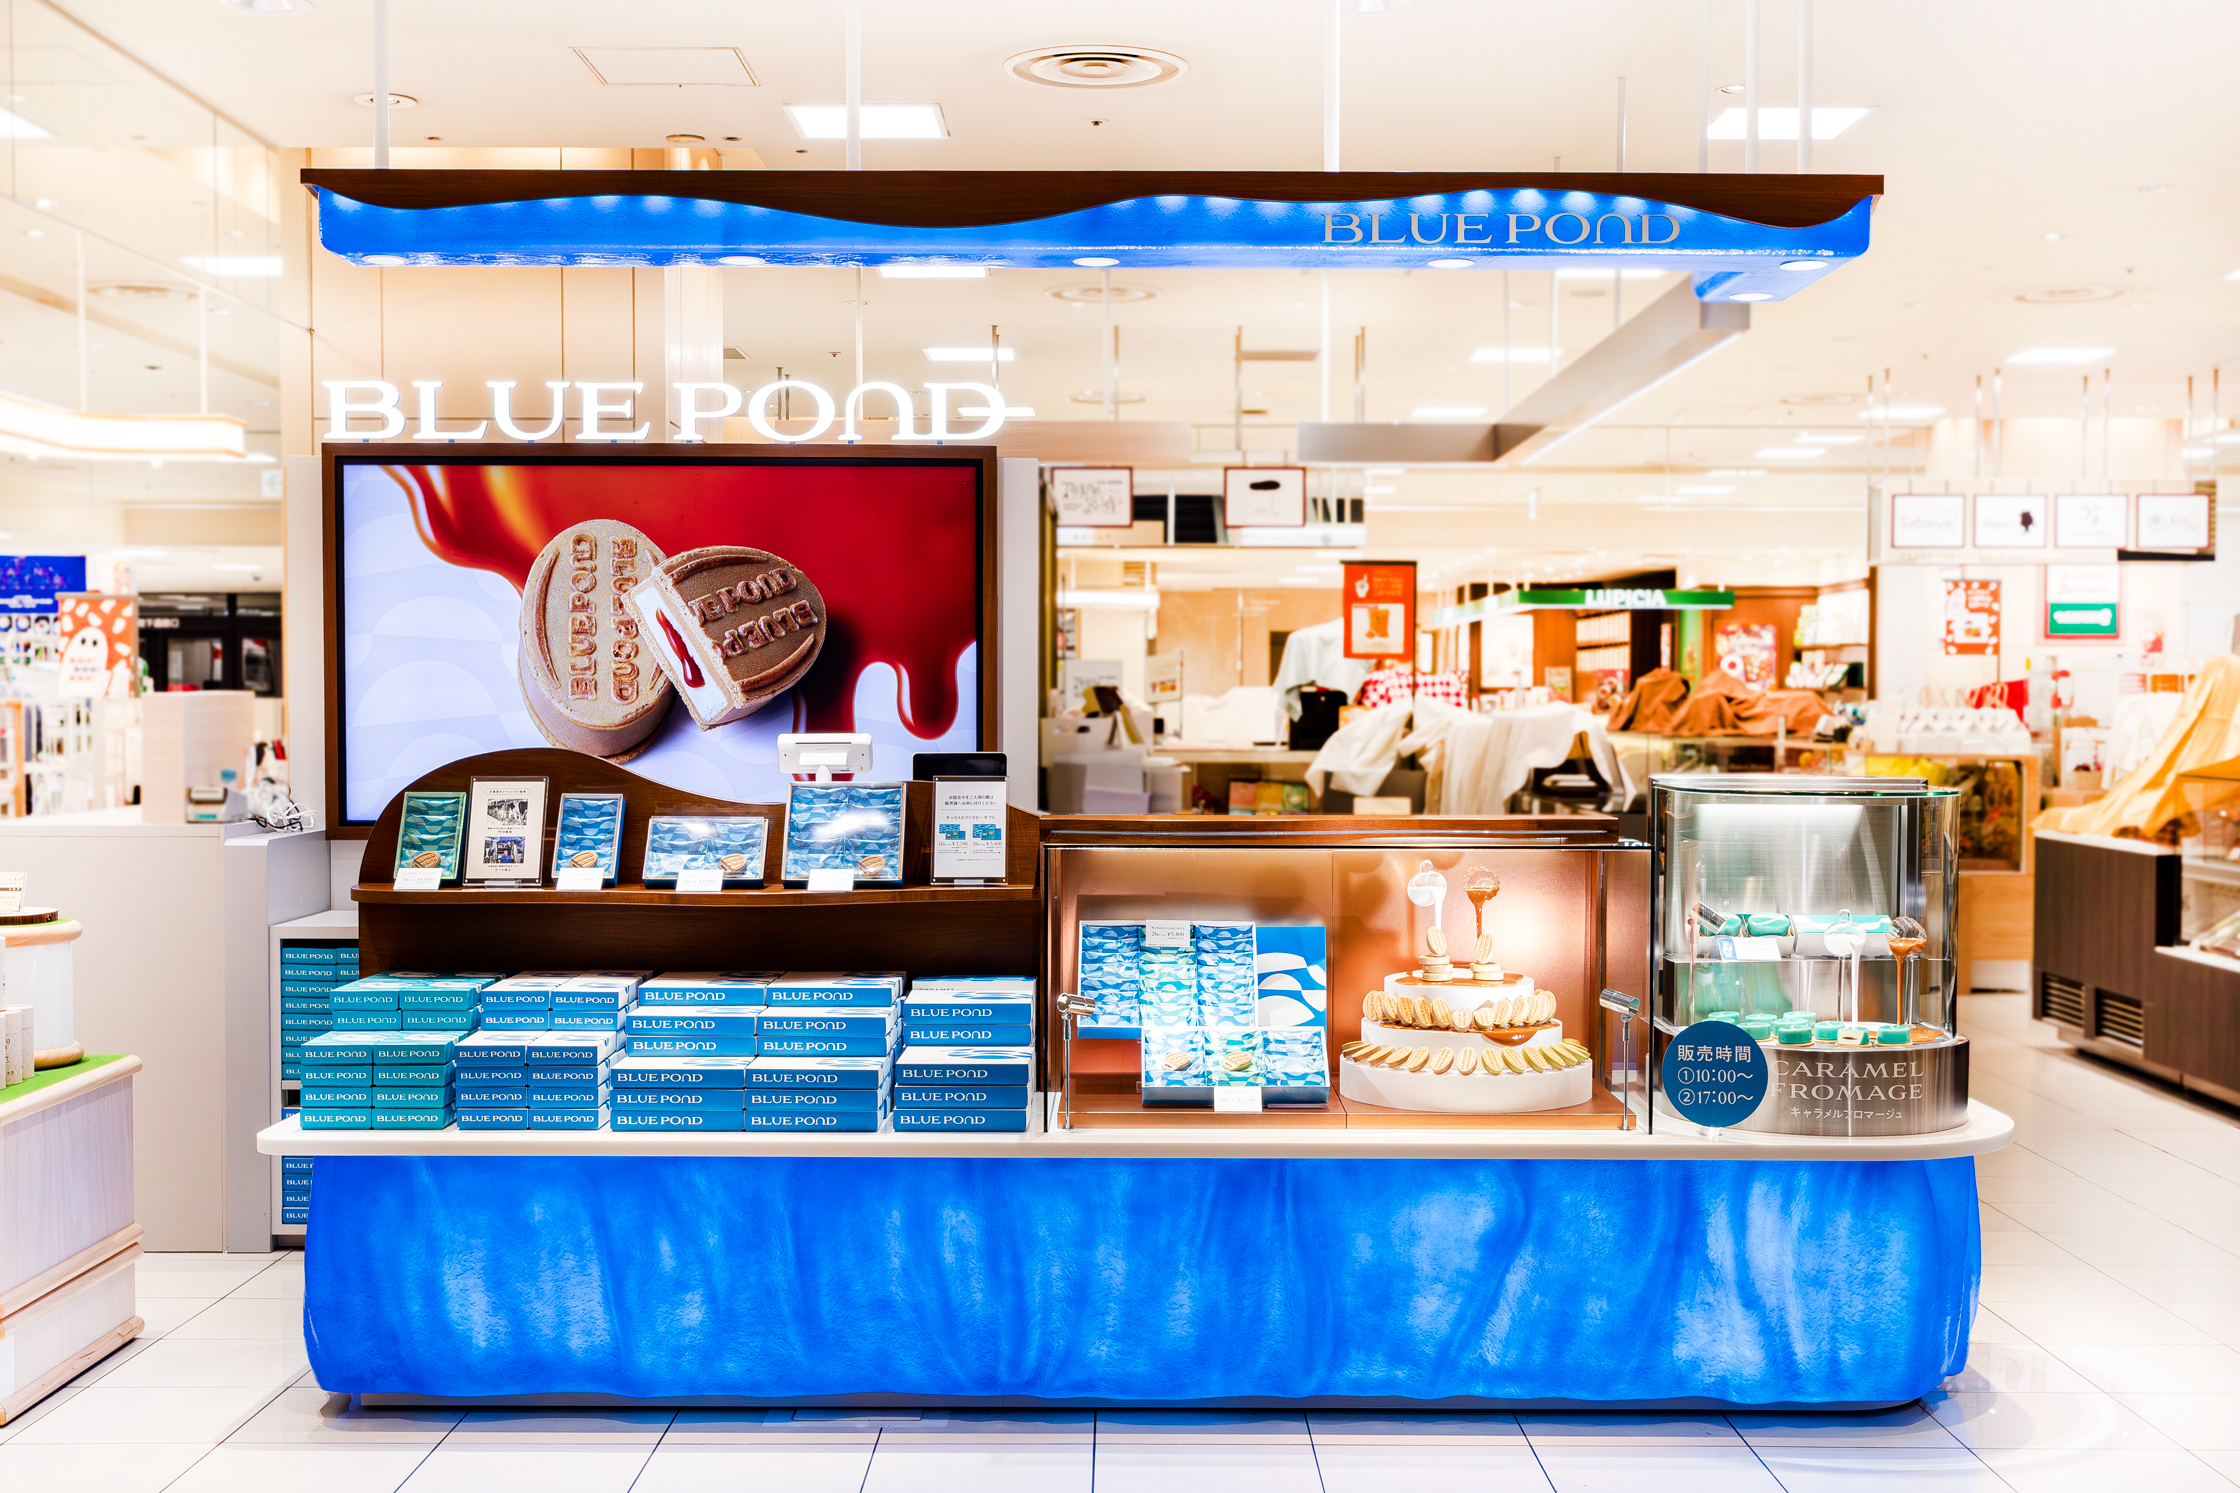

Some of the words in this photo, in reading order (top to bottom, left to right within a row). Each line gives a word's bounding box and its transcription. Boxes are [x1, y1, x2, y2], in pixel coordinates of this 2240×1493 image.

[1322, 213, 1492, 244] BLUE
[1505, 213, 1681, 244] POND
[322, 380, 650, 440] BLUE
[672, 380, 1005, 441] POND
[568, 533, 597, 614] POND
[716, 566, 797, 614] POND
[1584, 588, 1667, 607] LUPICIA
[568, 614, 598, 700] BLUE
[610, 616, 639, 706] POND
[645, 992, 684, 1000] BLUE
[685, 992, 726, 1001] POND
[772, 992, 812, 1000] BLUE
[813, 992, 854, 1000] POND
[952, 1009, 992, 1017] POND
[632, 1020, 672, 1029] BLUE
[674, 1020, 716, 1029] POND
[764, 1021, 803, 1030] BLUE
[805, 1021, 846, 1030] POND
[910, 1031, 950, 1039] BLUE
[952, 1031, 992, 1039] POND
[633, 1042, 673, 1050] BLUE
[675, 1042, 716, 1051] POND
[764, 1042, 804, 1050] BLUE
[805, 1042, 847, 1051] POND
[1677, 1044, 1752, 1062] 販売時間
[1769, 1060, 1924, 1078] CARAMEL
[617, 1073, 658, 1082] BLUE
[661, 1073, 703, 1082] POND
[752, 1074, 794, 1082] BLUE
[796, 1074, 838, 1083] POND
[902, 1070, 944, 1078] BLUE
[946, 1070, 988, 1078] POND
[1770, 1082, 1923, 1101] FROMAGE
[617, 1095, 658, 1103] BLUE
[660, 1095, 702, 1104] POND
[751, 1095, 792, 1104] BLUE
[795, 1095, 837, 1104] POND
[902, 1093, 942, 1101] BLUE
[945, 1093, 986, 1101] POND
[617, 1116, 658, 1125] BLUE
[660, 1116, 703, 1125] POND
[751, 1117, 792, 1125] BLUE
[795, 1117, 837, 1126] POND
[900, 1116, 941, 1124] BLUE
[944, 1116, 986, 1124] POND
